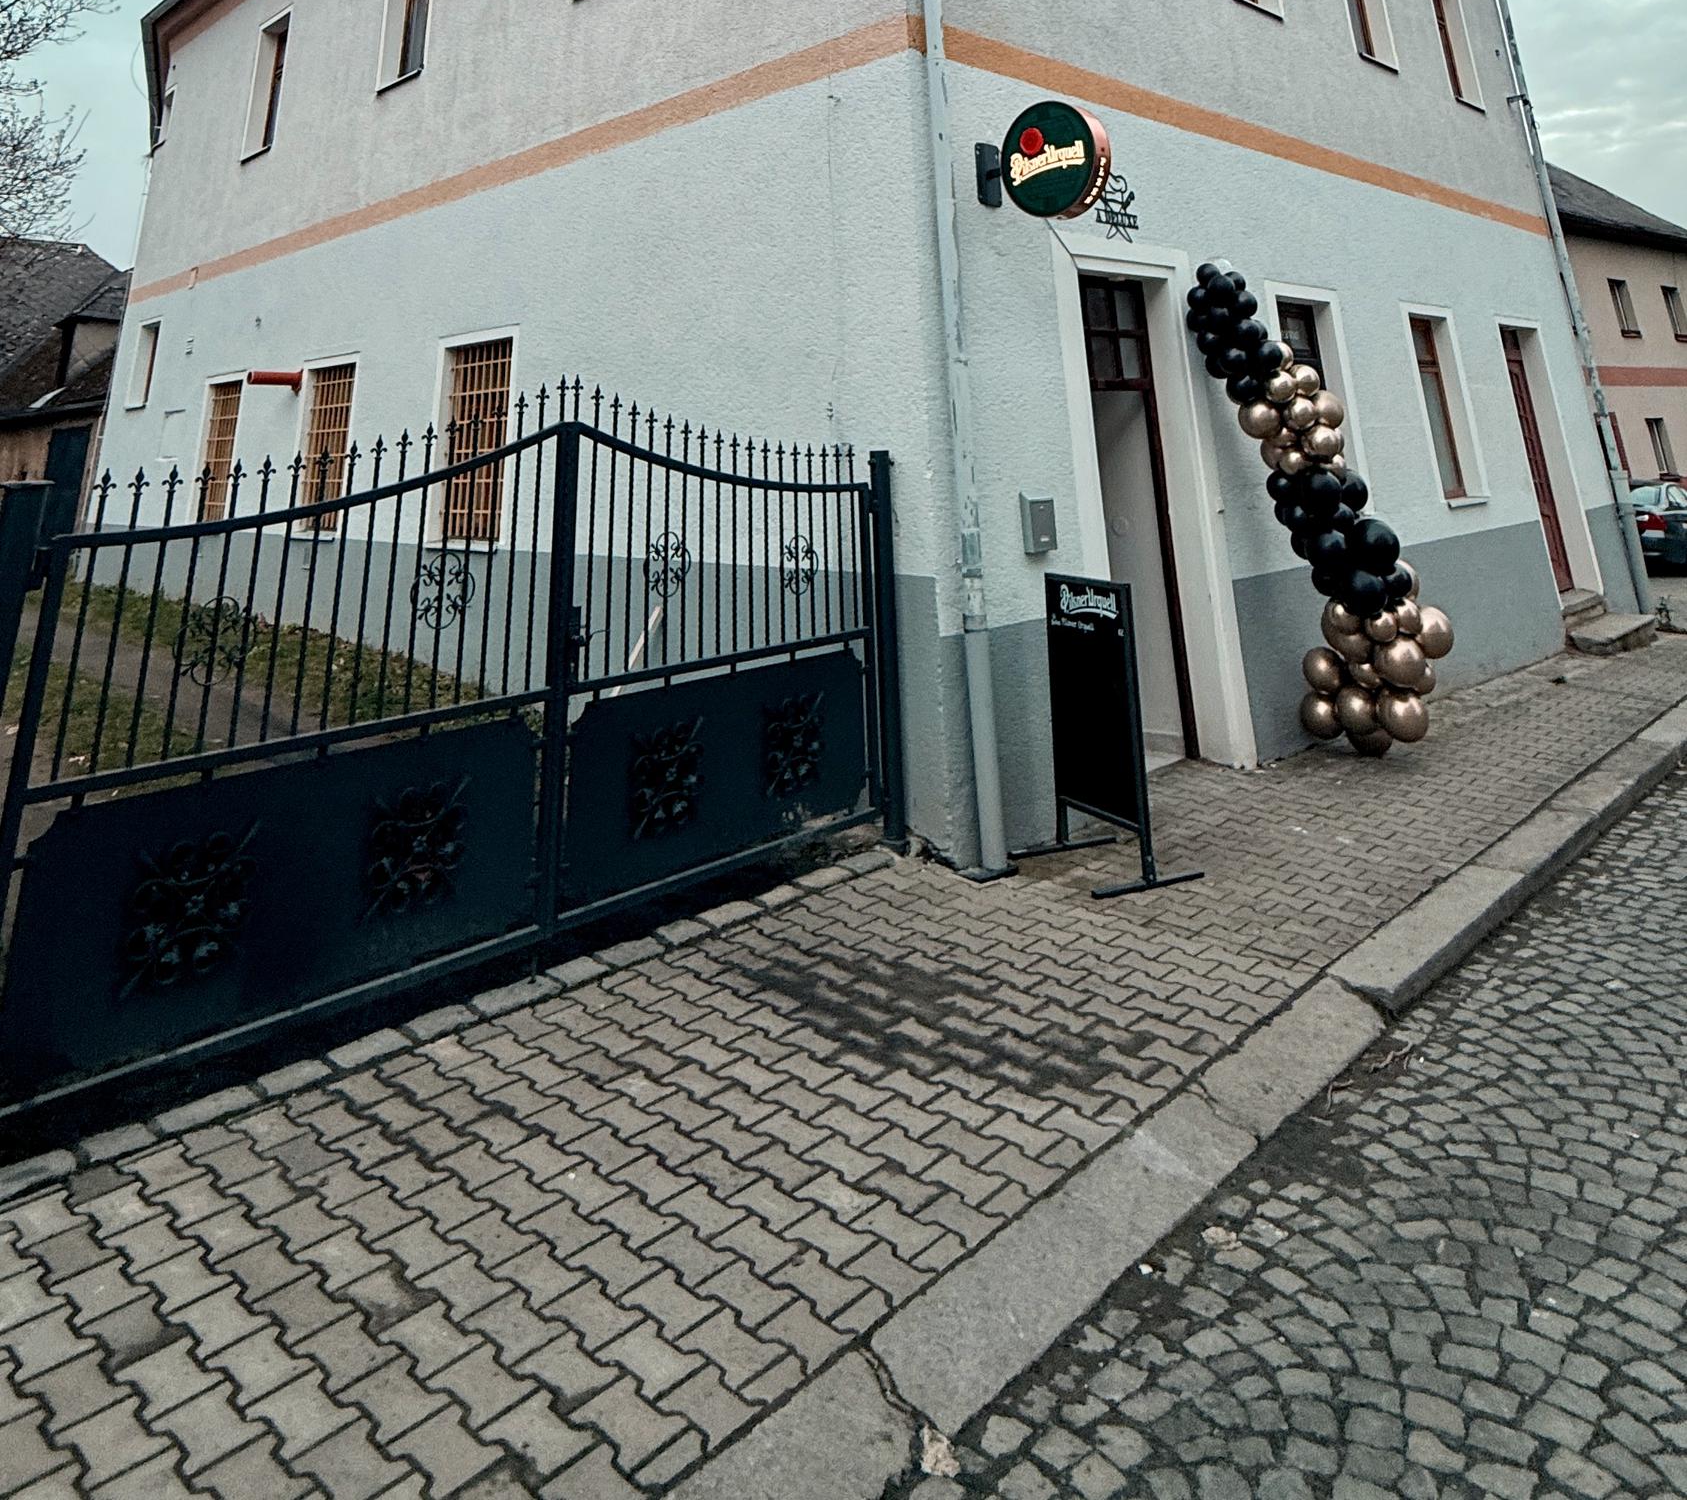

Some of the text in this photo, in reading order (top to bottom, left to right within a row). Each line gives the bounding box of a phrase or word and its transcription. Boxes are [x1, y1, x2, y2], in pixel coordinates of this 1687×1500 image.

[1011, 140, 1084, 186] Pilsner Urquell
[1060, 584, 1116, 617] Pilsner Urquell
